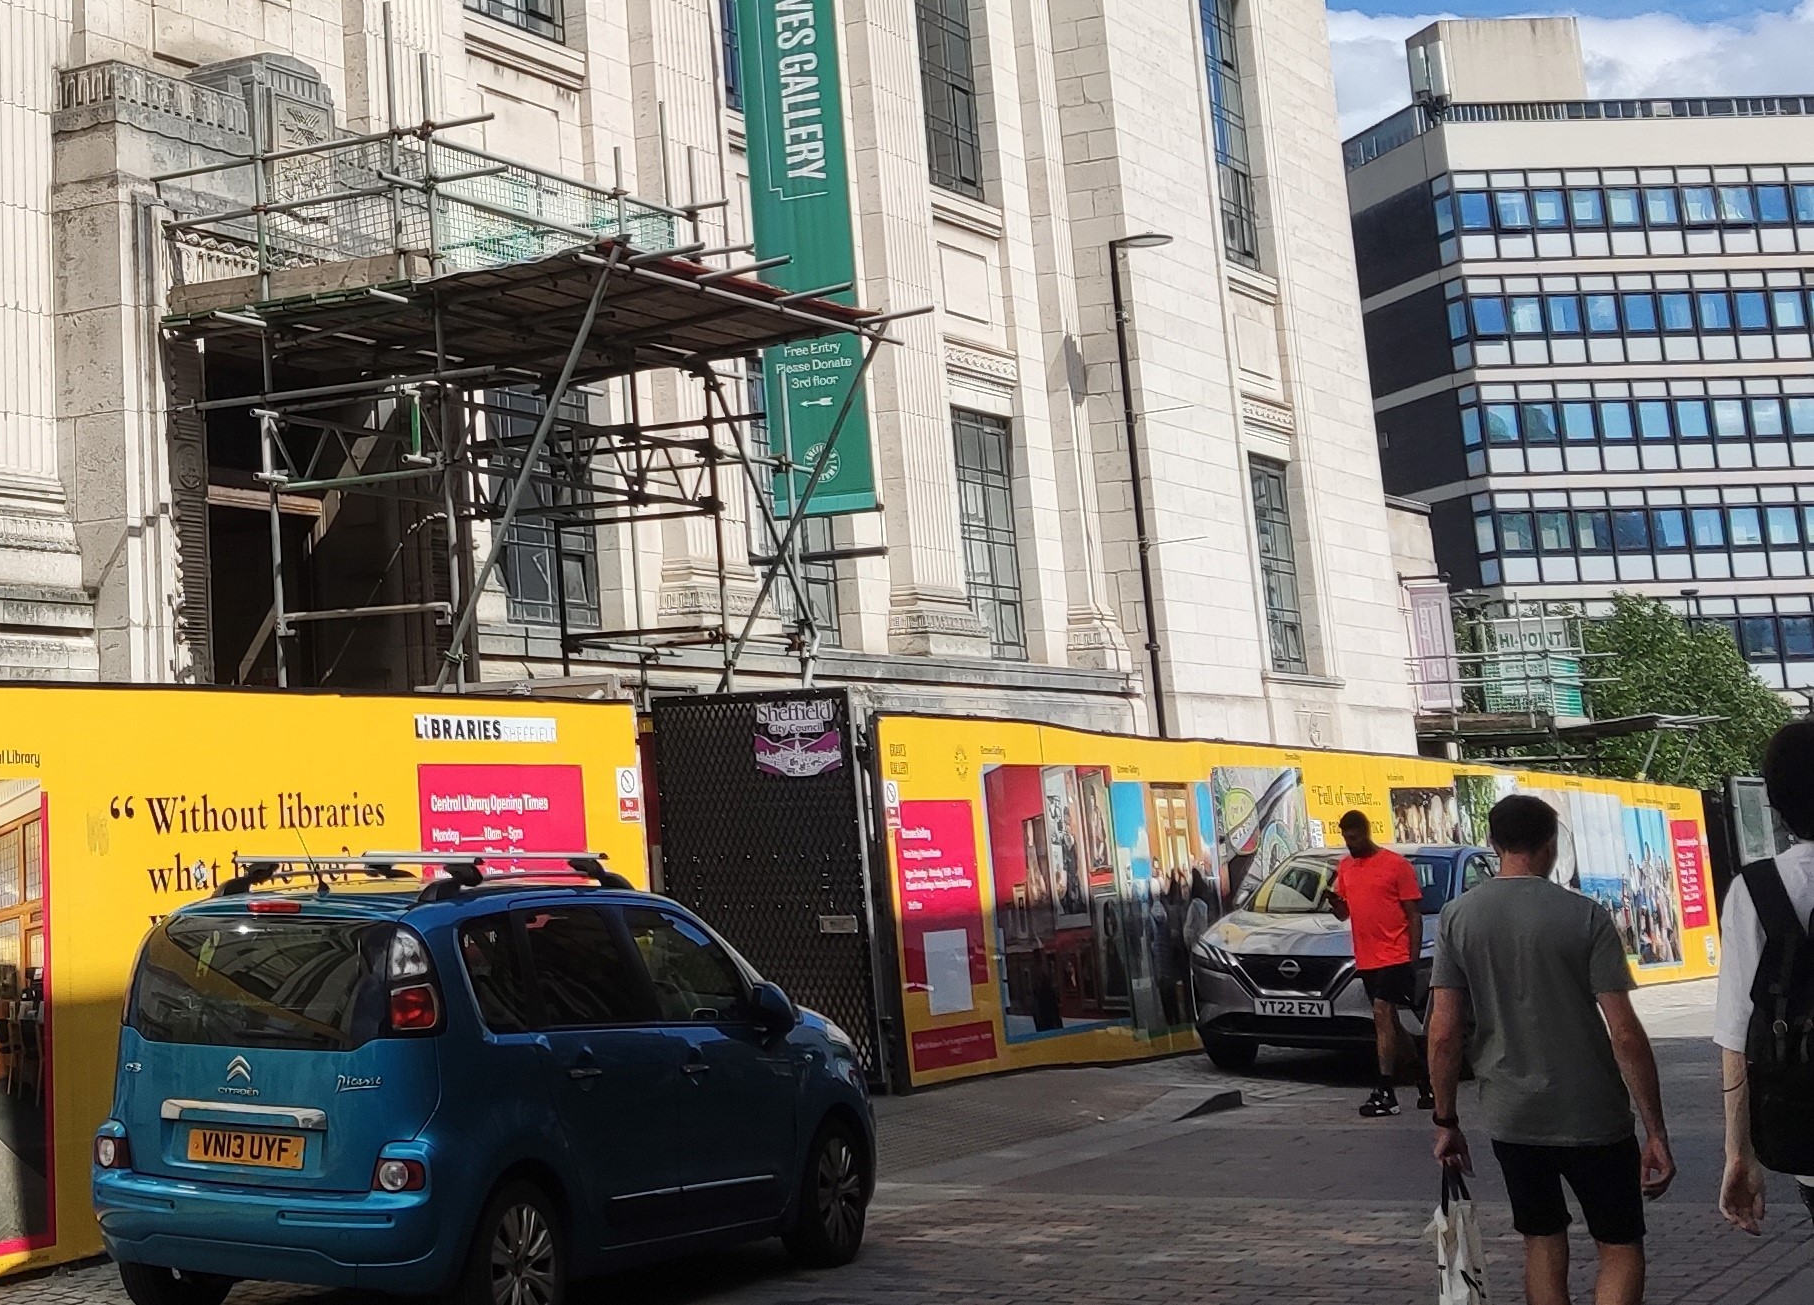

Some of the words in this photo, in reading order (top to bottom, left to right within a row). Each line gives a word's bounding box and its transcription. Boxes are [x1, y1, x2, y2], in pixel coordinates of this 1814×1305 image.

[778, 51, 828, 181] GALLERY
[783, 346, 809, 358] Free
[810, 342, 841, 354] Entry
[776, 363, 811, 375] Please
[811, 356, 853, 371] Donate
[791, 377, 812, 390] 3rd
[812, 375, 840, 387] floor
[758, 699, 833, 722] Sheffield
[769, 724, 786, 736] City
[788, 723, 824, 733] Council
[6, 749, 41, 768] Library
[277, 791, 385, 830] libraries
[430, 792, 460, 812] Central
[461, 794, 490, 816] Library
[490, 793, 522, 816] Opening
[522, 792, 549, 811] Times
[1259, 1000, 1295, 1014] YT22
[1297, 1001, 1325, 1016] EZV
[202, 1132, 244, 1159] VN13
[249, 1135, 292, 1162] UYF
